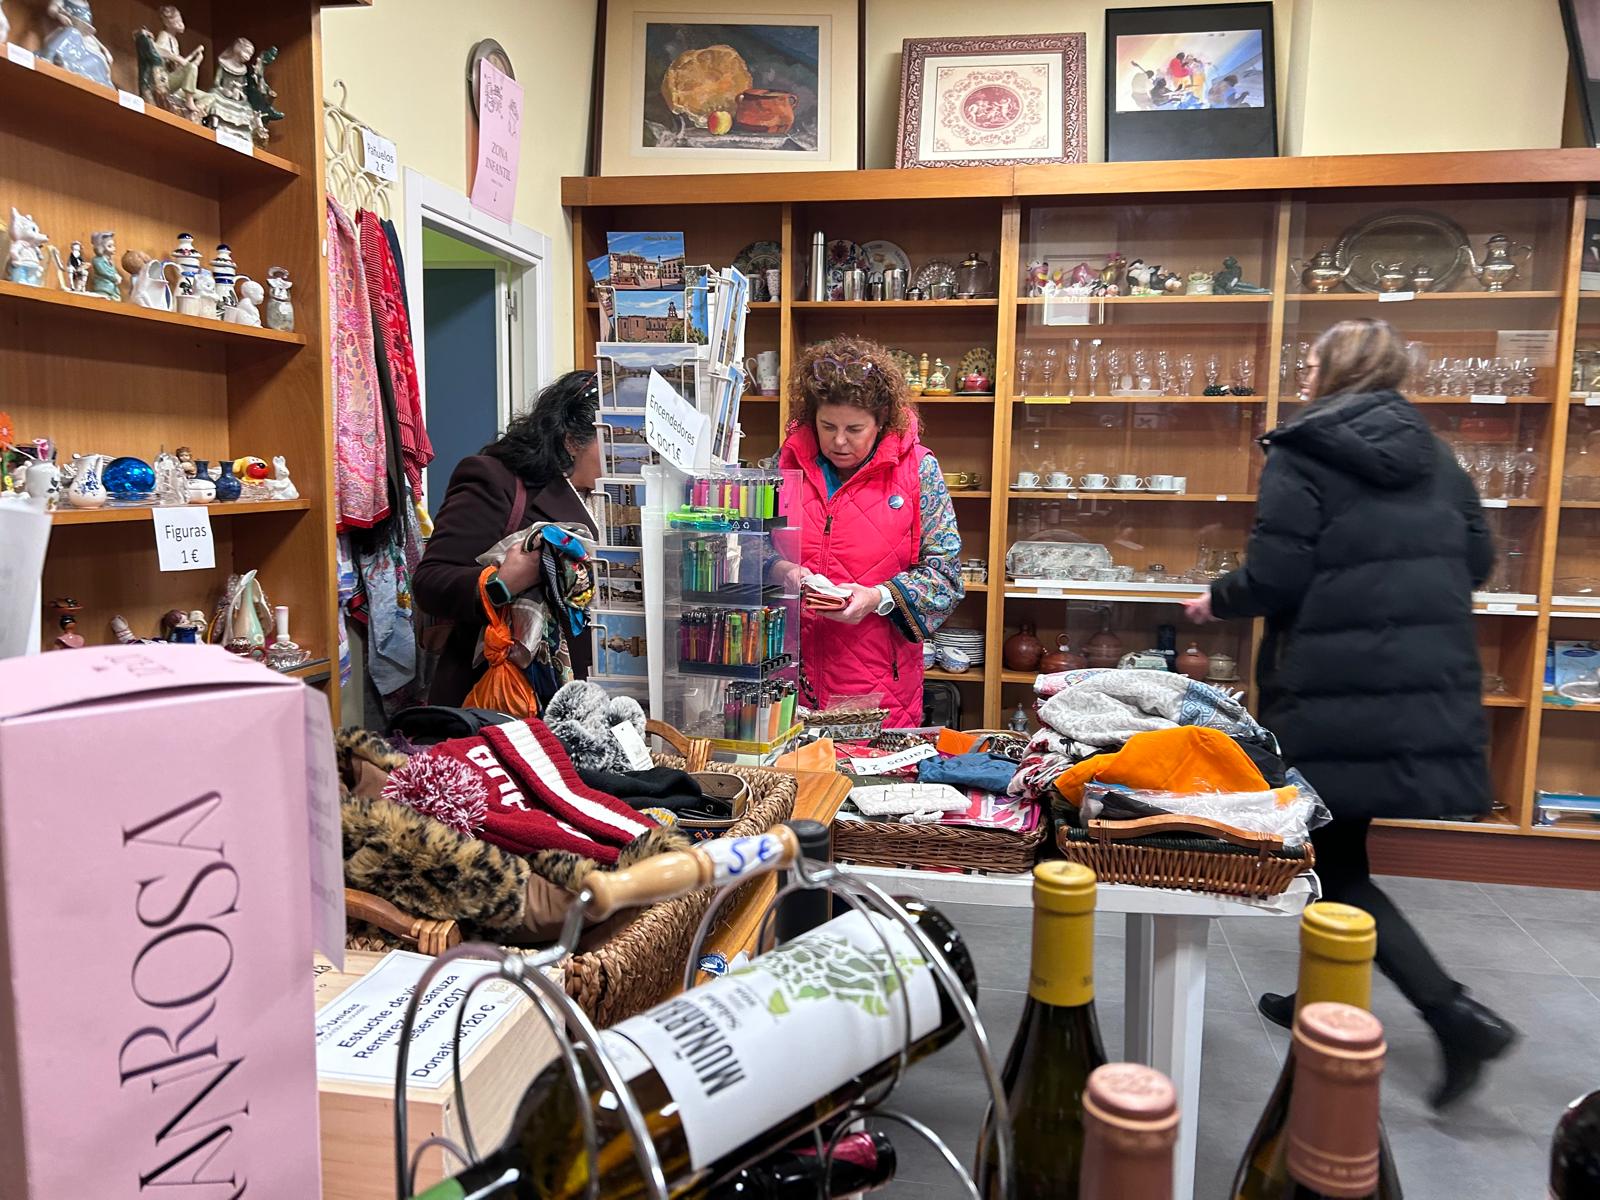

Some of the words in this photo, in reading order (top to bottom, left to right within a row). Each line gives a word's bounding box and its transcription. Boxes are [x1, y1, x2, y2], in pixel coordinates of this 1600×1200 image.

[367, 142, 394, 164] Pañuelos
[491, 142, 508, 161] ZONA
[650, 394, 695, 446] Encendedores
[165, 524, 207, 542] Figuras
[887, 748, 934, 765] Varios
[119, 790, 249, 1200] ANROSA
[337, 1010, 392, 1048] Estuche
[388, 996, 408, 1008] de
[394, 1009, 447, 1045] eserva
[438, 987, 467, 1008] 2017
